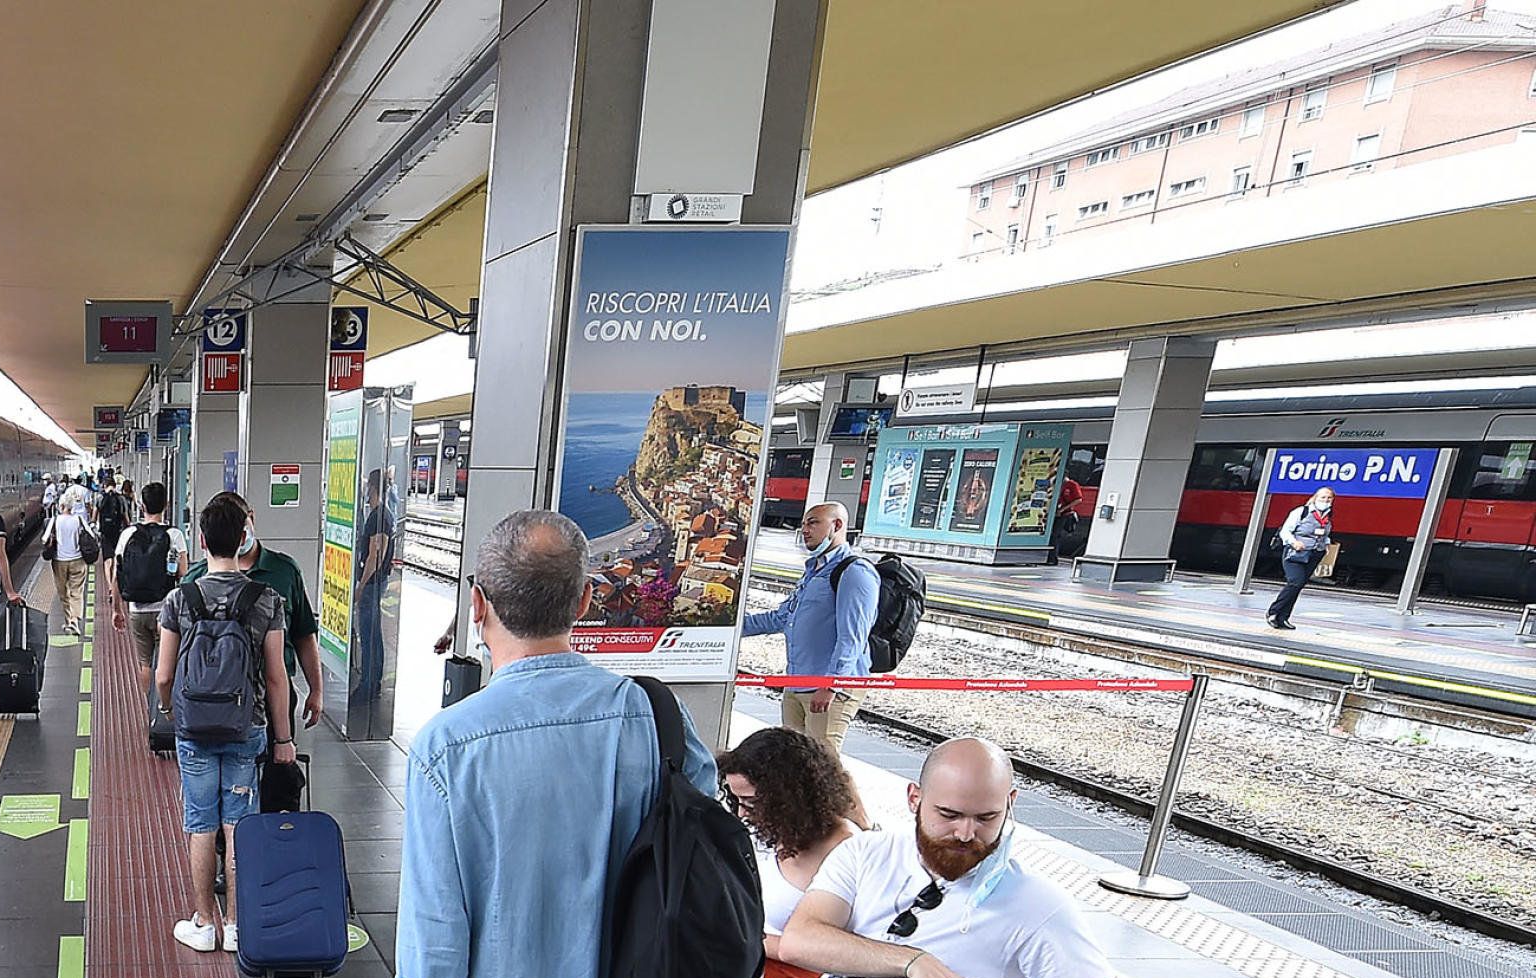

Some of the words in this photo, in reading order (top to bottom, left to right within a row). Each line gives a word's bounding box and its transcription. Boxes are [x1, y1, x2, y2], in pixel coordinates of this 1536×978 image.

[586, 292, 688, 314] RISCOPRI
[693, 292, 771, 314] L'ITALIA
[123, 326, 136, 340] 11
[211, 321, 234, 339] 12
[584, 320, 643, 341] CON
[649, 320, 708, 341] NOI.
[1277, 455, 1357, 482] Torino
[1363, 456, 1422, 484] P.N.
[570, 635, 603, 644] EEKEND
[604, 635, 654, 644] CONSECUTIVI
[679, 641, 726, 649] TRENITALIA
